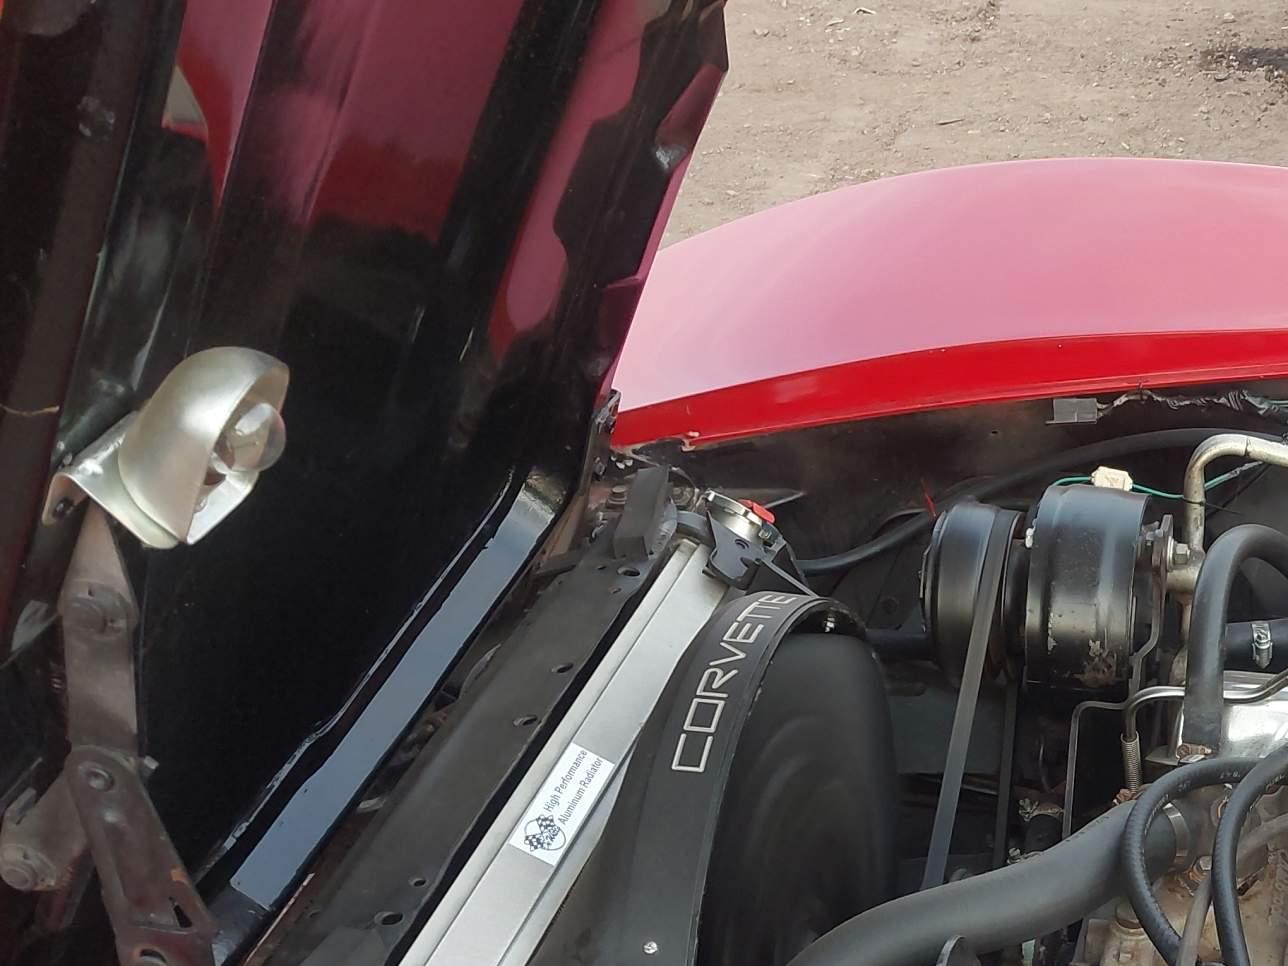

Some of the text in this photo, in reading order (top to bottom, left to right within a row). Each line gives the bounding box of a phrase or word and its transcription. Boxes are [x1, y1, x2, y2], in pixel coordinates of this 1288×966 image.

[671, 594, 798, 773] CORVETTE
[543, 792, 562, 813] High
[554, 749, 588, 795] Performance
[558, 757, 604, 825] Aluminum Radiator
